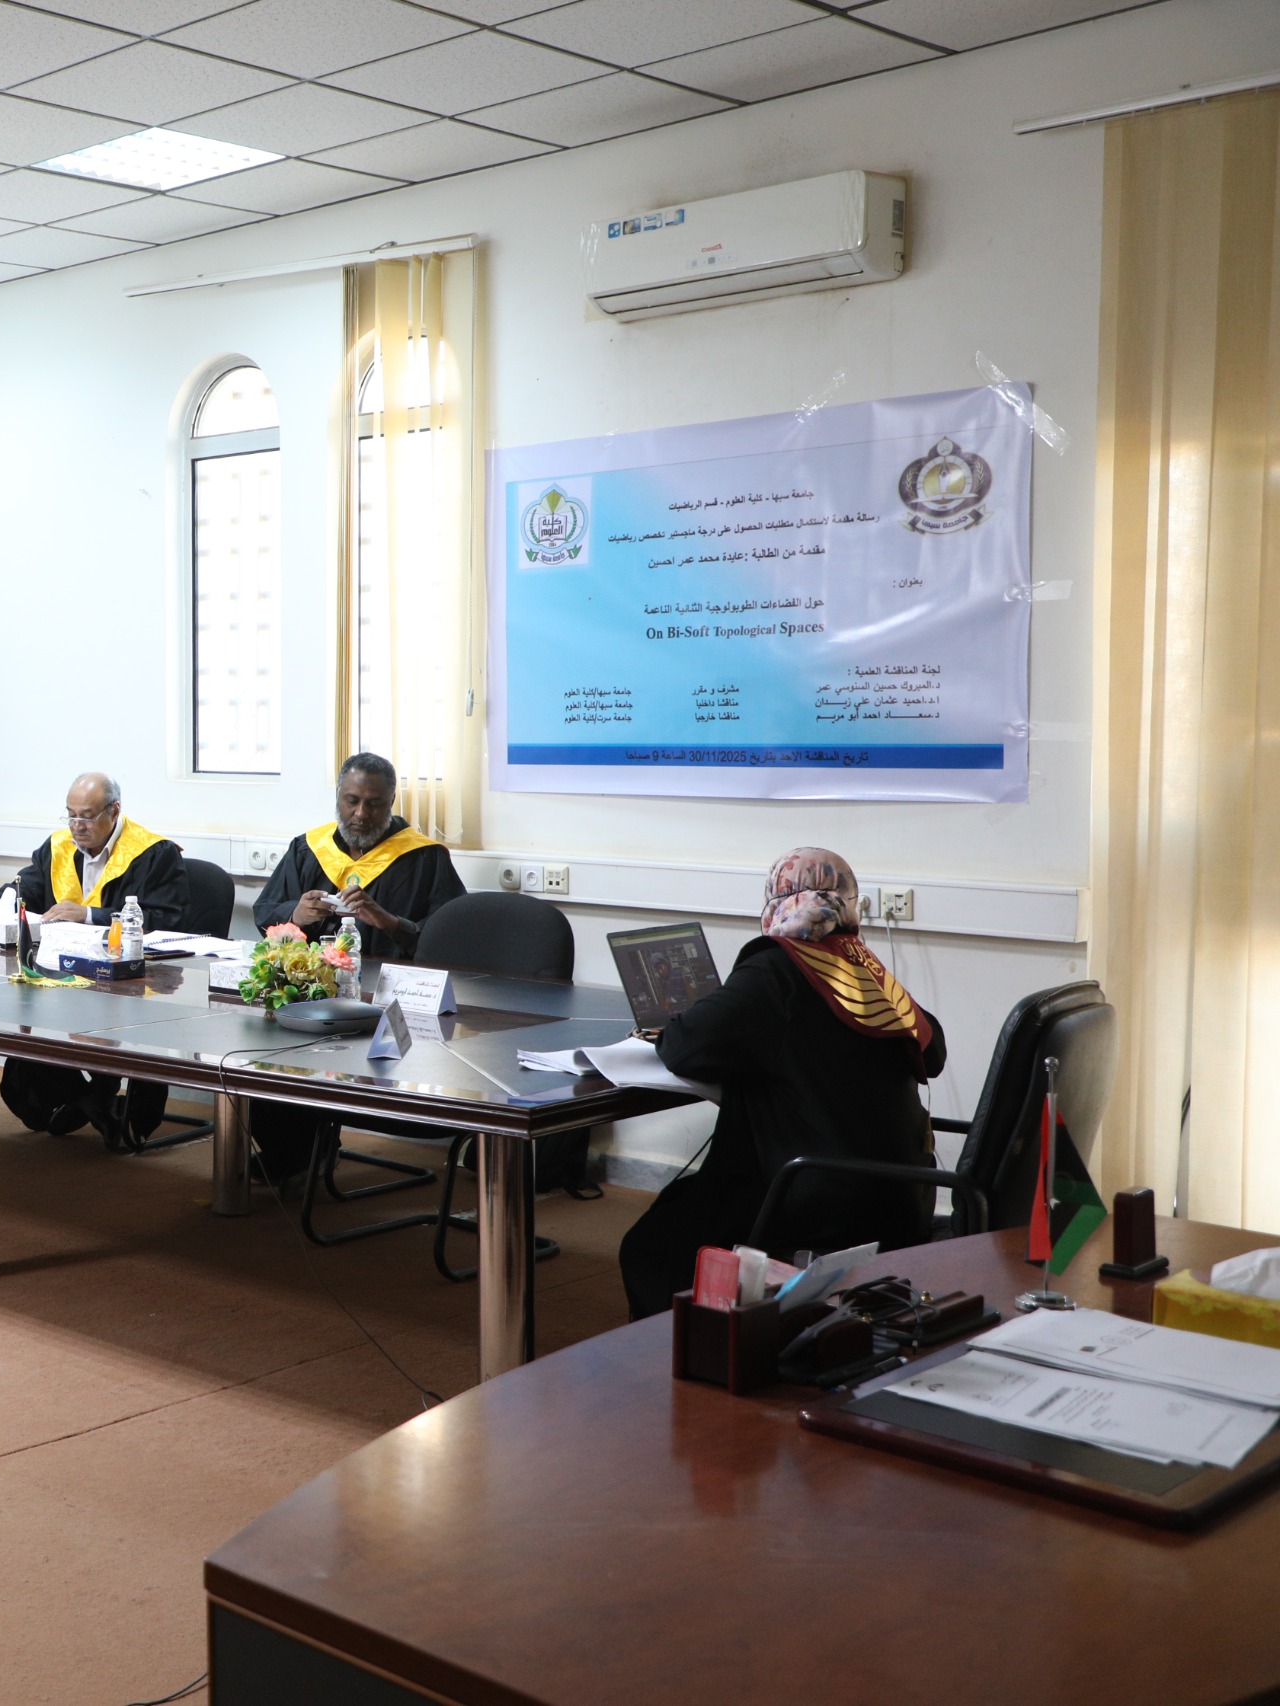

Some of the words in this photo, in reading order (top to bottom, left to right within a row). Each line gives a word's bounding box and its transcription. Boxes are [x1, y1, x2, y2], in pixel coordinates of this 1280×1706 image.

[748, 494, 763, 505] كلية
[772, 493, 789, 503] سبها
[791, 489, 814, 500] جامعة
[669, 500, 702, 512] الرياضيات
[704, 497, 718, 510] قسم
[726, 495, 746, 507] العلوم
[796, 516, 829, 529] لاستكمال
[832, 514, 855, 524] مقدمة
[857, 512, 880, 523] رسالة
[942, 514, 969, 529] جامعة
[717, 525, 731, 536] على
[734, 522, 763, 533] الحصول
[765, 519, 794, 531] متطلبات
[638, 531, 665, 542] تخصص
[668, 529, 695, 540] ماجستير
[697, 526, 715, 537] درجة
[608, 534, 636, 544] رياضيات
[752, 547, 779, 561] الطالبة
[782, 549, 796, 559] من
[799, 544, 825, 555] مقدمة
[648, 556, 675, 569] احسين
[678, 556, 694, 567] عمر
[698, 555, 719, 563] محمد
[898, 577, 923, 588] بعنوان
[675, 602, 703, 615] الثنائية
[705, 600, 757, 614] الطوبولوجية
[760, 597, 801, 609] الفضاءات
[805, 597, 824, 609] حول
[644, 604, 672, 614] الناعمة
[646, 627, 663, 640] On
[667, 625, 710, 639] Bi-Soft
[713, 624, 776, 639] Topological
[779, 621, 825, 637] Spaces
[855, 666, 881, 678] العلمية
[884, 665, 918, 675] المناقشة
[921, 664, 941, 676] لجنة
[563, 688, 580, 698] العلوم
[613, 686, 632, 696] جامعة
[691, 685, 707, 696] مقرر
[717, 684, 740, 694] مشرف
[816, 684, 831, 693] عمر
[834, 682, 870, 695] السنوسي
[873, 684, 897, 693] حسين
[565, 701, 581, 711] العلوم
[614, 700, 633, 710] جامعة
[695, 699, 715, 709] داخليا
[717, 699, 739, 708] مناقشا
[854, 697, 870, 708] علي
[874, 695, 898, 707] عثمان
[564, 714, 581, 724] العلوم
[613, 713, 632, 723] جامعة
[695, 713, 716, 723] خارجيا
[718, 712, 740, 721] مناقشا
[626, 750, 650, 761] صباحا
[652, 750, 659, 761] 9
[661, 750, 686, 761] الساعة
[689, 751, 747, 763] 30/11/2025
[749, 751, 775, 766] بتاريخ
[804, 750, 840, 761] المناقشة
[842, 751, 869, 766] تاريخ
